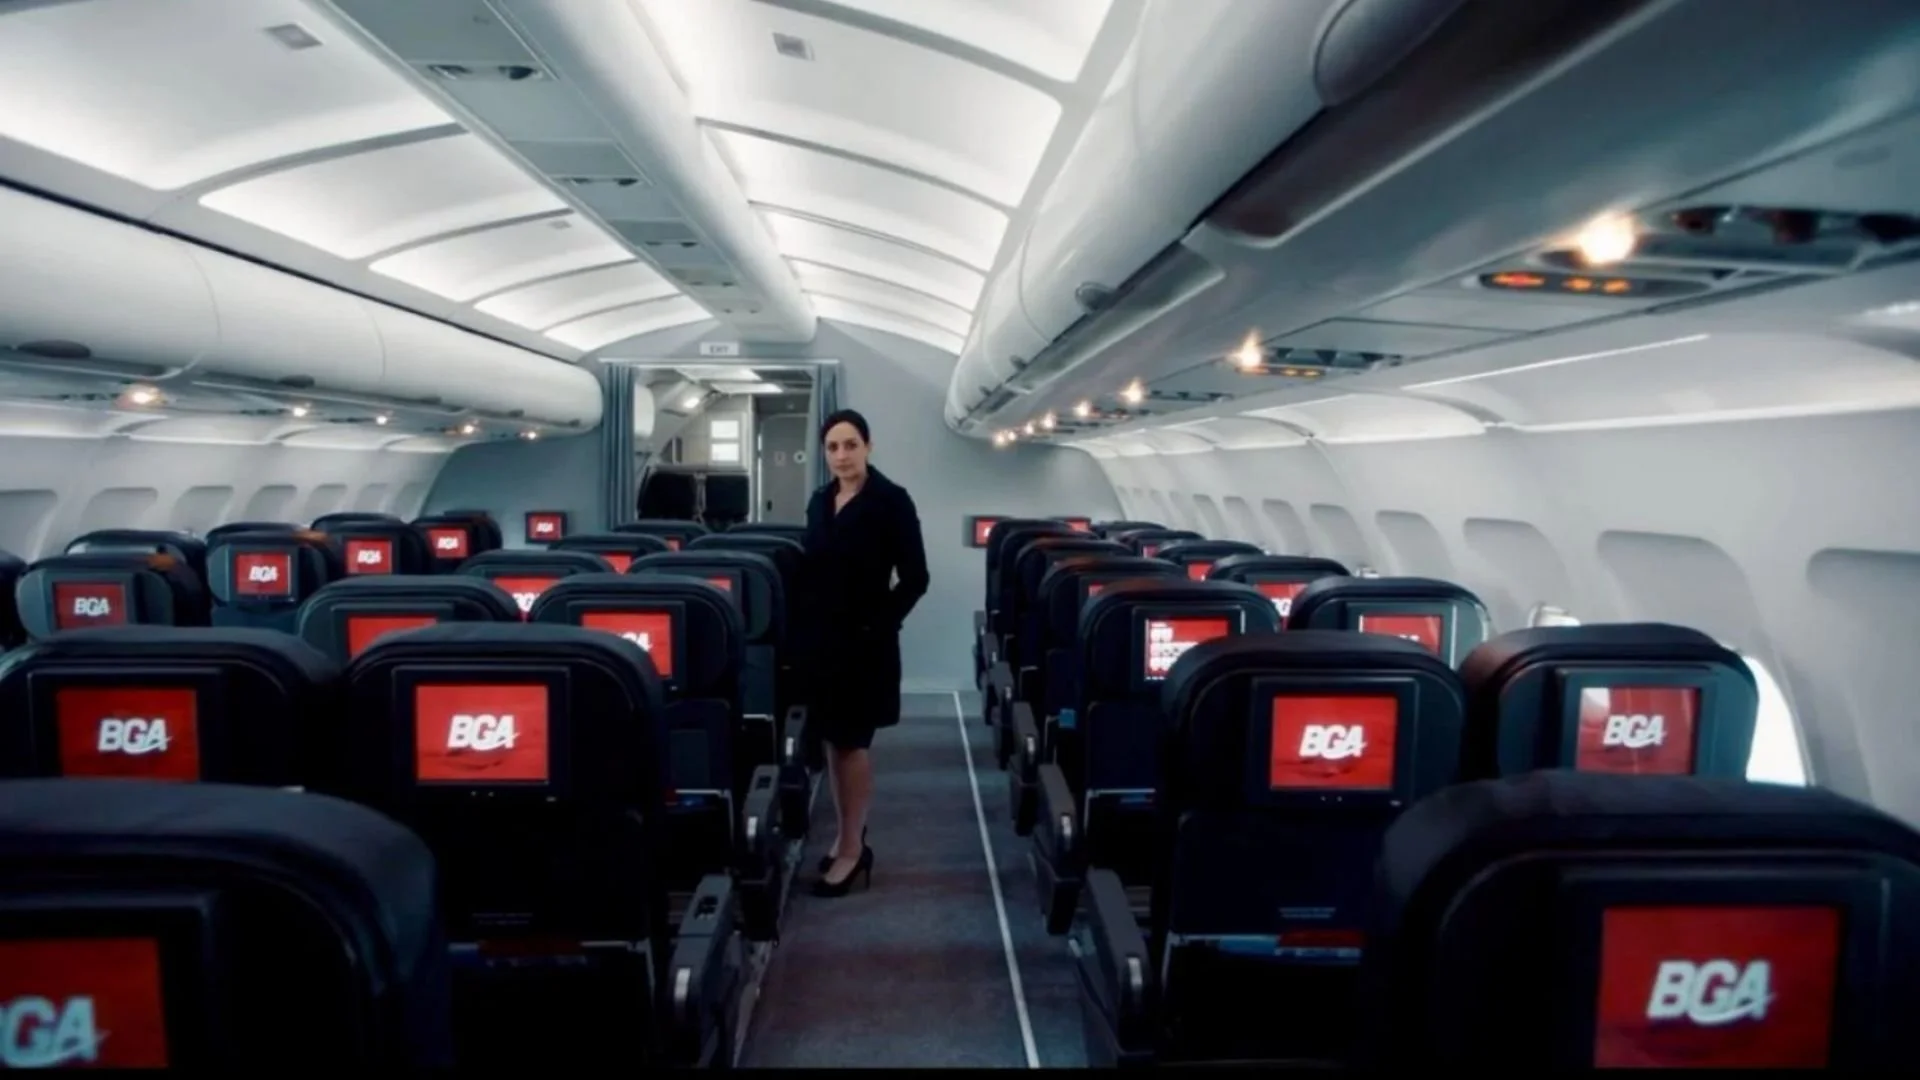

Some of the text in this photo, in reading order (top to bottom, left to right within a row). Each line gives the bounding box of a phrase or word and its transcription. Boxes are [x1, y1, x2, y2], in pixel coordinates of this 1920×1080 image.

[248, 565, 279, 583] BGA
[73, 596, 111, 617] BGA
[97, 717, 172, 755] BGA
[446, 714, 521, 752] BGA
[1298, 723, 1368, 760] BGA
[1602, 714, 1666, 749] BGA
[1646, 959, 1775, 1025] BGA
[0, 994, 108, 1069] GA
